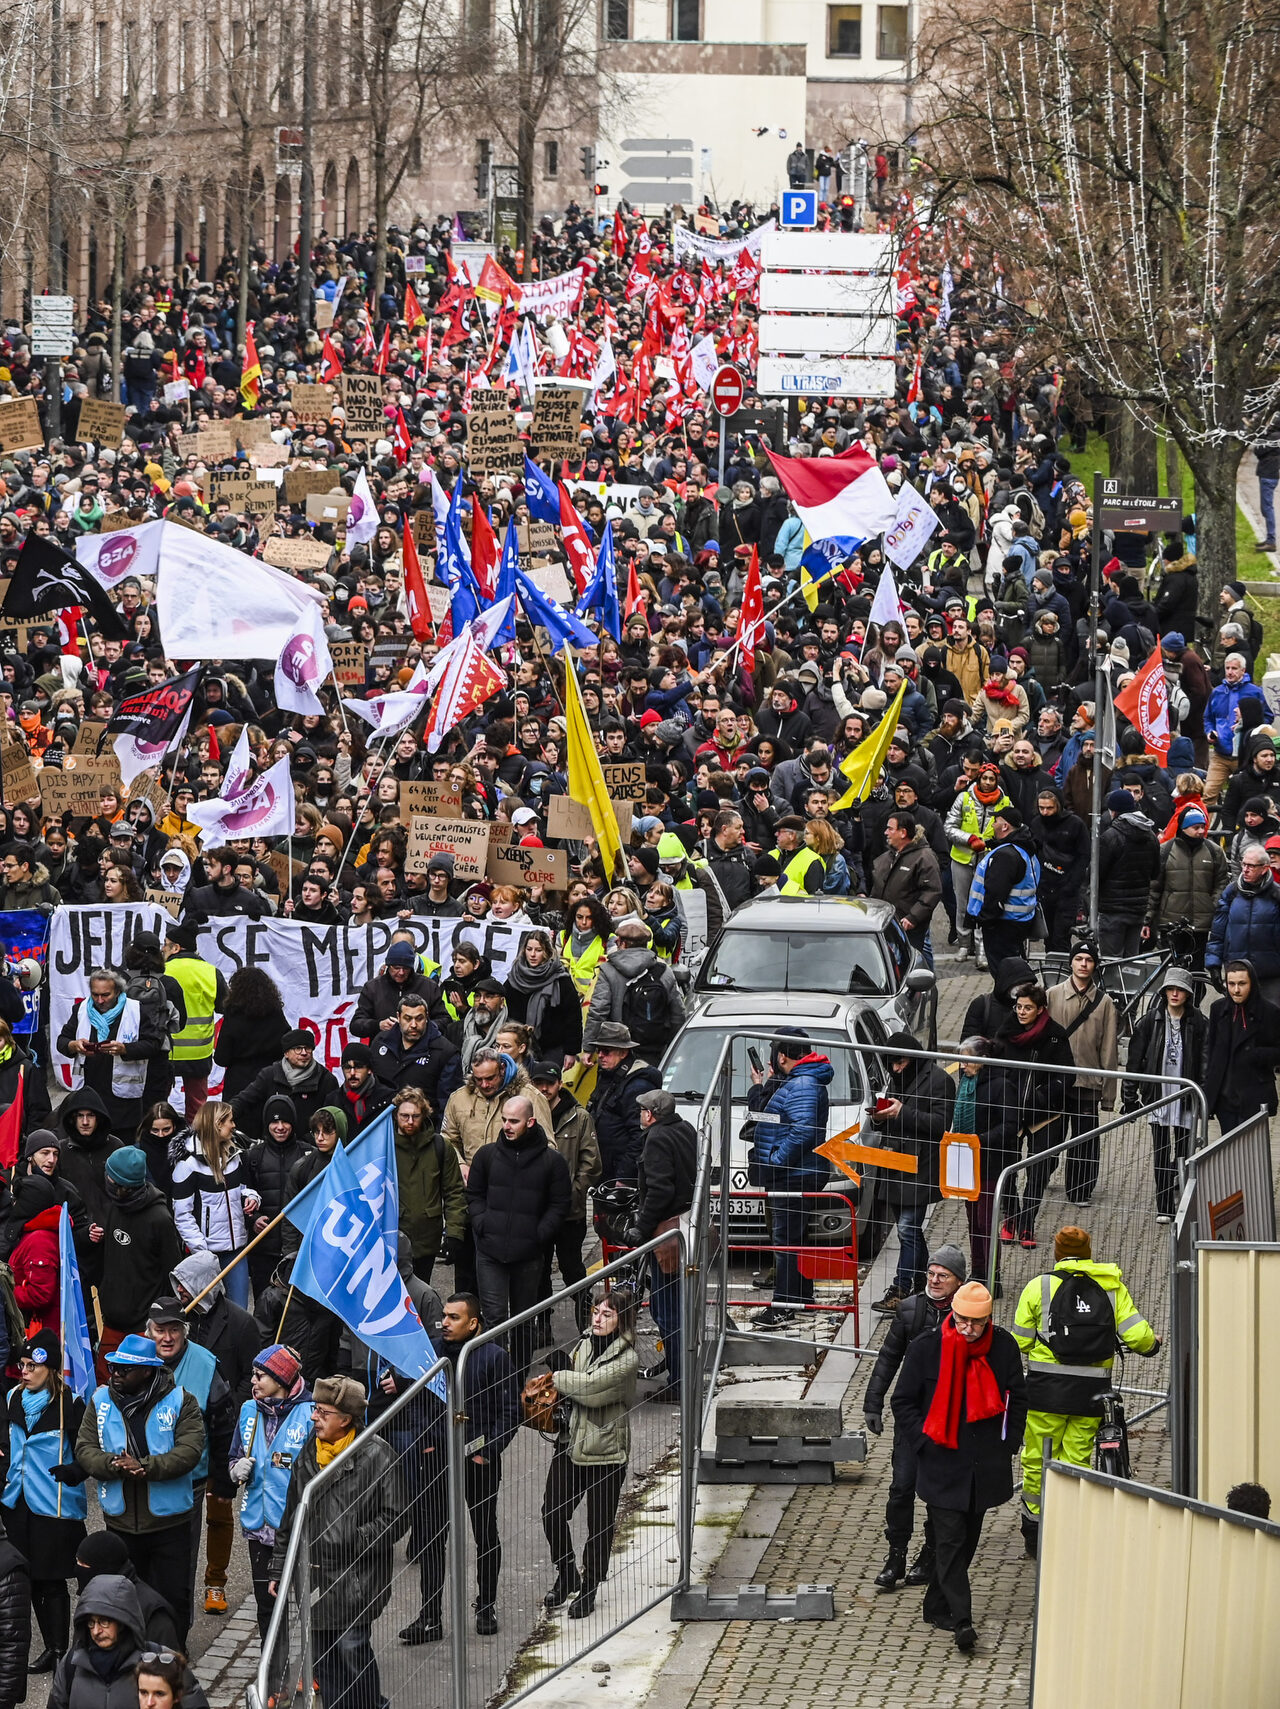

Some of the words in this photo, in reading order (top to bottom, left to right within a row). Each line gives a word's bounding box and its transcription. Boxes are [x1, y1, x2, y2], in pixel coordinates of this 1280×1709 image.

[790, 198, 806, 220] P
[346, 378, 376, 394] NON
[782, 376, 823, 390] ULTRAS
[542, 390, 571, 399] FAUT
[536, 401, 579, 410] POUSSER
[347, 406, 382, 420] STOP
[470, 416, 488, 434] 64
[86, 758, 100, 768] 64
[47, 775, 68, 787] DIS
[72, 774, 96, 787] PAPY
[409, 786, 419, 794] 64
[421, 787, 438, 795] ANS
[49, 802, 62, 814] LA
[409, 804, 420, 812] 64
[421, 805, 437, 814] ANS
[415, 820, 429, 830] LES
[416, 833, 446, 842] VEULENT
[524, 869, 555, 883] COLÈRE
[144, 892, 156, 902] LA
[1076, 1294, 1091, 1312] LA
